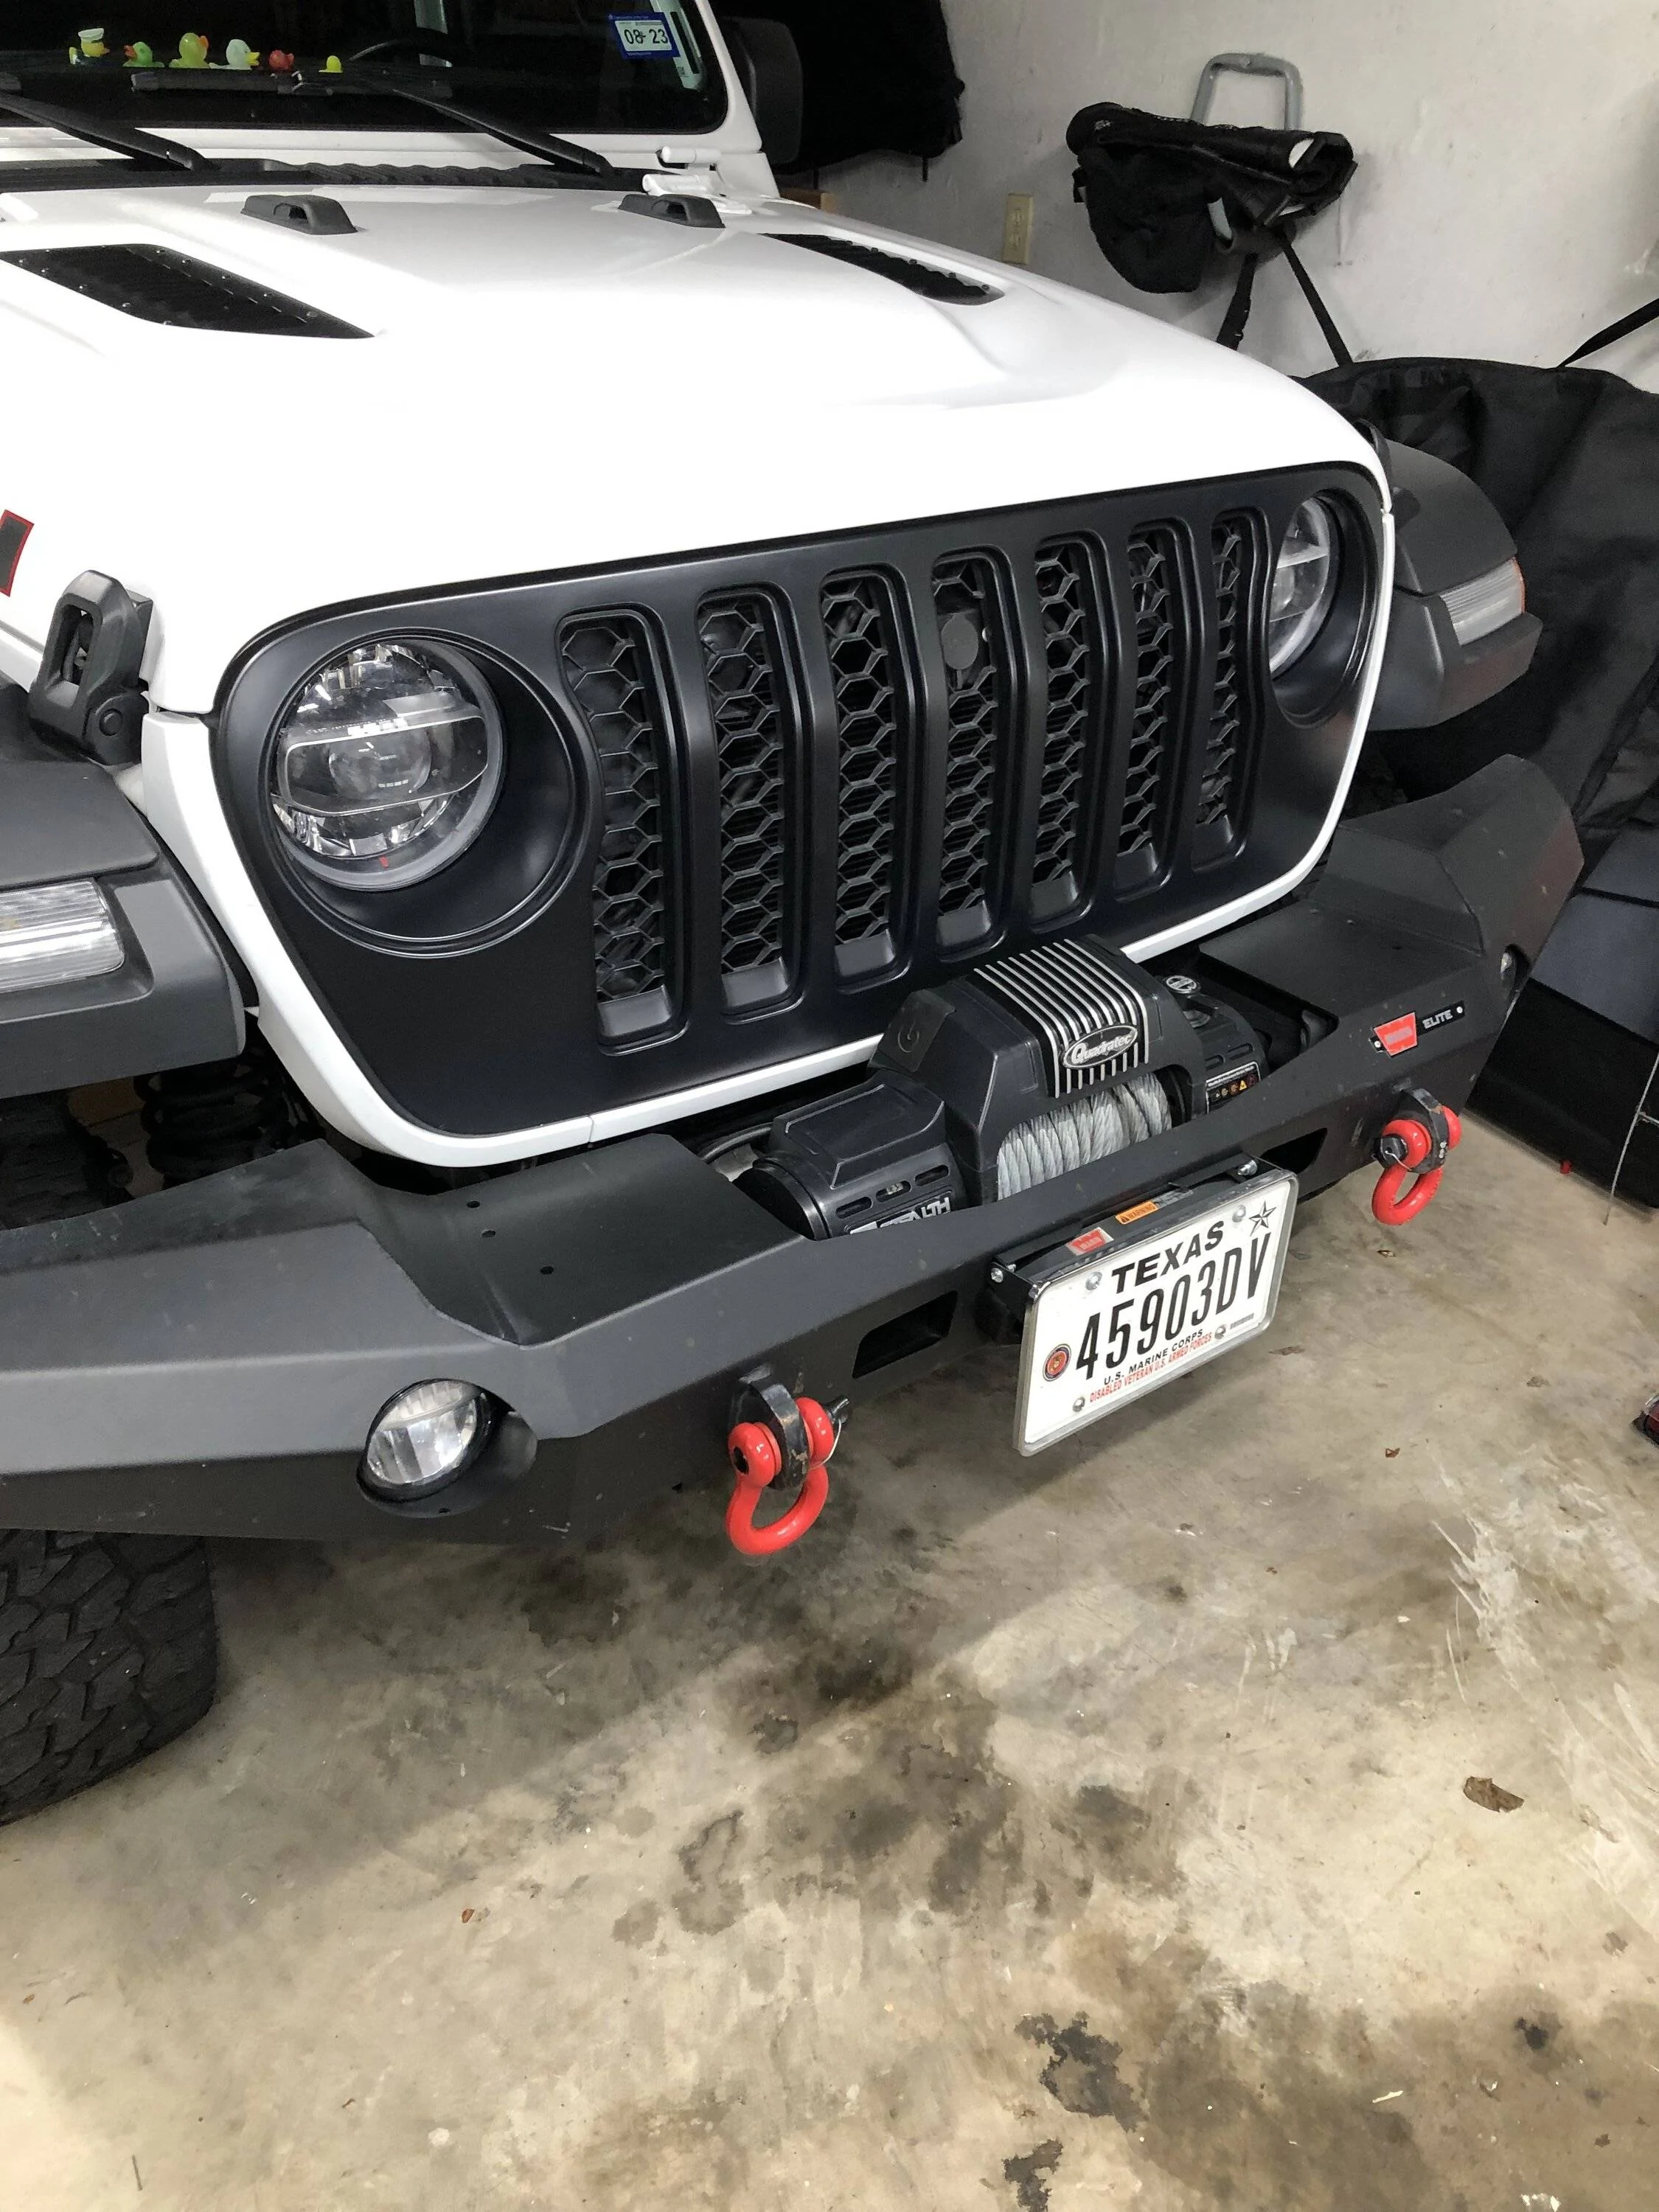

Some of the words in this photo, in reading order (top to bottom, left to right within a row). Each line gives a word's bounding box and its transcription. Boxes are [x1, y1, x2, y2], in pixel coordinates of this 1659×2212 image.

[649, 29, 668, 44] 23
[1422, 1009, 1453, 1029] ELITE
[1071, 1034, 1133, 1064] Quadratec
[1111, 1220, 1224, 1294] TEXAS
[1076, 1231, 1272, 1380] 45903DV
[1090, 1380, 1122, 1402] DISABLED
[1124, 1366, 1153, 1386] VETERAN
[1167, 1347, 1189, 1364] ARMED
[1189, 1332, 1213, 1352] FORCES
[1104, 1371, 1124, 1385] U.S.
[1128, 1348, 1168, 1374] MARINE
[1171, 1329, 1203, 1352] CORPS
